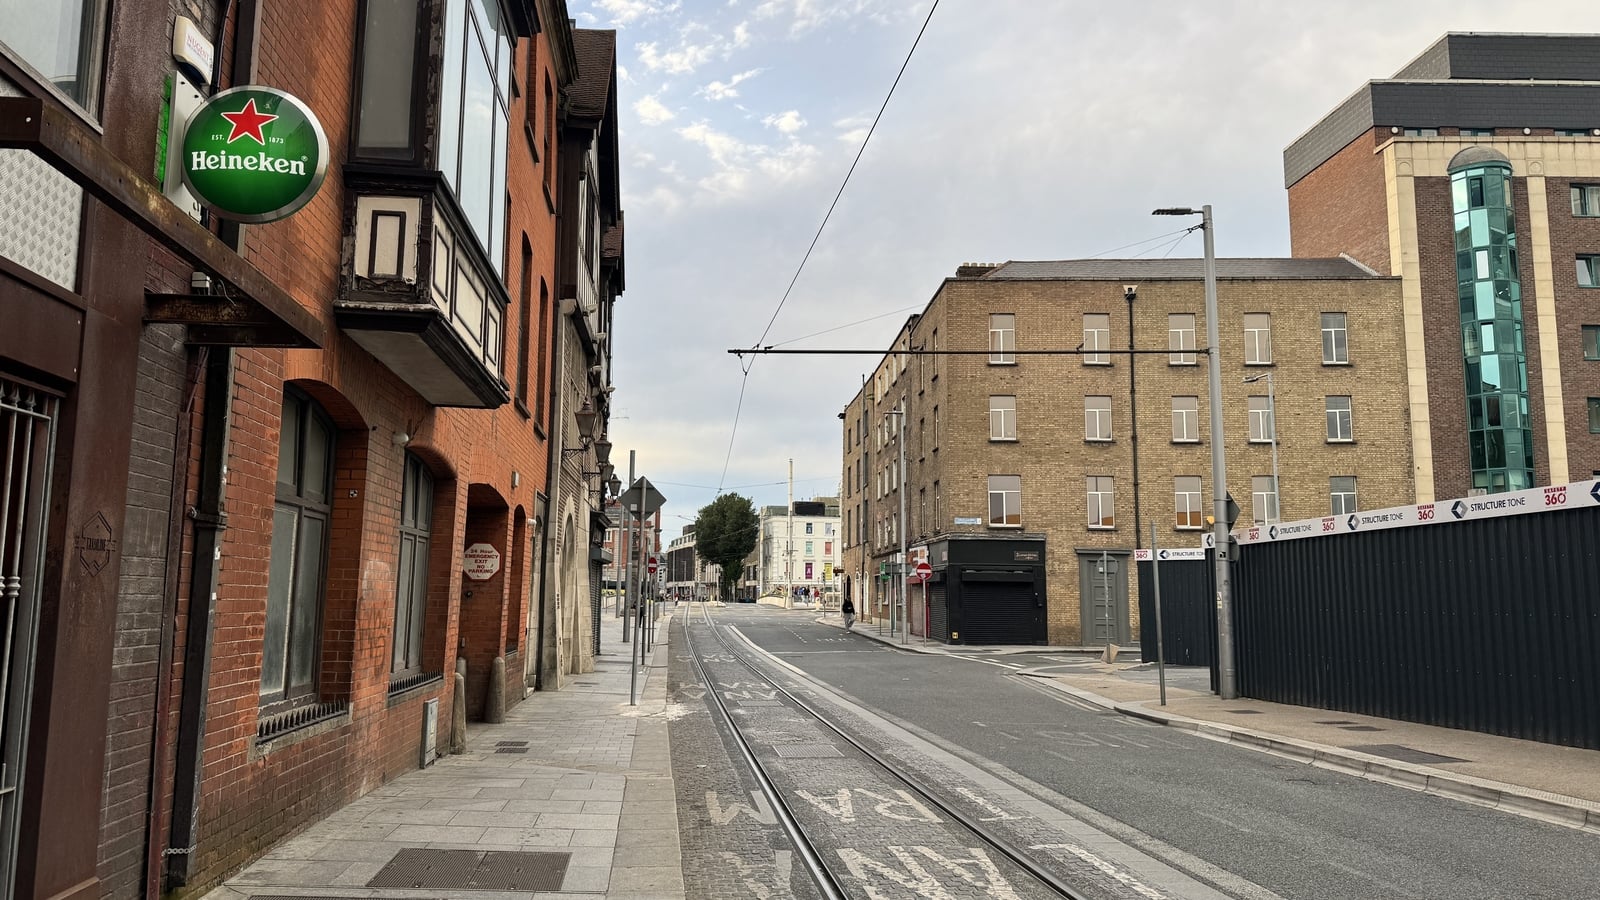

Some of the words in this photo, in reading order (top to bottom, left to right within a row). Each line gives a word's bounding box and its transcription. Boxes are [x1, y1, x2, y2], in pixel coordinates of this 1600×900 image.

[268, 136, 284, 144] 1873
[191, 150, 306, 176] Heineken
[1470, 499, 1506, 512] STRUCTURE
[1507, 497, 1526, 507] TONE
[1544, 493, 1567, 506] 360
[1361, 514, 1389, 525] STRUCTURE
[1389, 512, 1403, 521] TONE
[1417, 509, 1435, 521] 360
[1279, 525, 1301, 535] STRUCTURE
[1301, 524, 1312, 533] TONE
[1322, 522, 1335, 532] 360
[1249, 531, 1260, 541] 360
